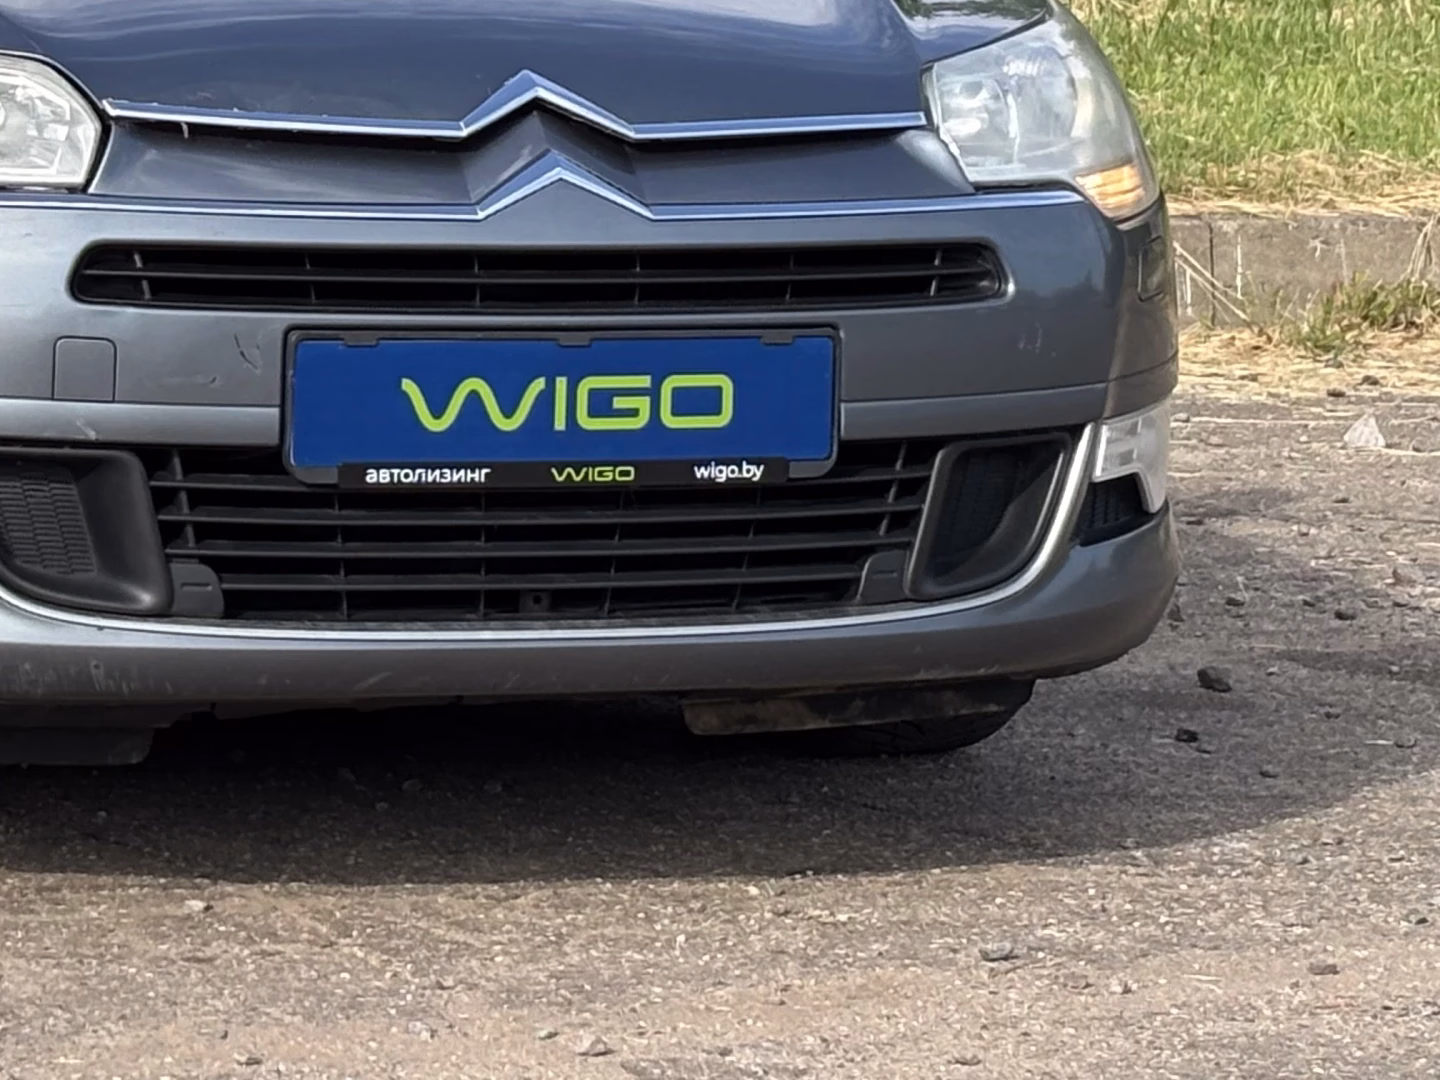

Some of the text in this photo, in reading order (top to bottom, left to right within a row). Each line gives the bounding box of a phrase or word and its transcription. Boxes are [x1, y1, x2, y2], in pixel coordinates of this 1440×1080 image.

[401, 373, 734, 432] WIGO
[364, 467, 492, 484] автолизинг
[550, 465, 636, 482] WIGO
[693, 459, 765, 483] wigo.by
